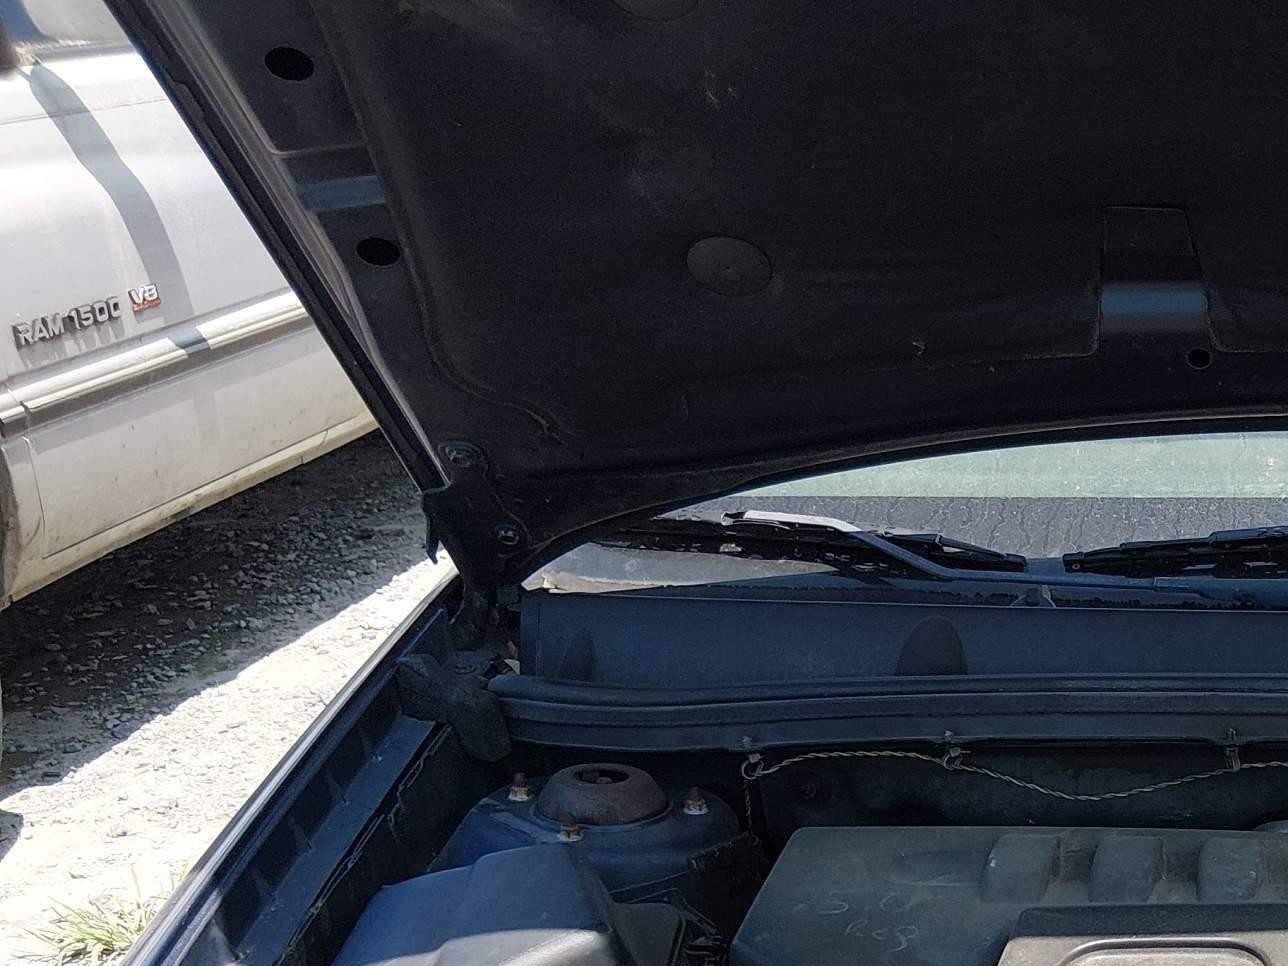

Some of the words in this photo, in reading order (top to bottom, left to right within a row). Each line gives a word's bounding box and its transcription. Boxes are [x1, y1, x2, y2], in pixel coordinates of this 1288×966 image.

[13, 312, 65, 346] RAM
[66, 296, 121, 330] 1500
[128, 283, 159, 305] V8
